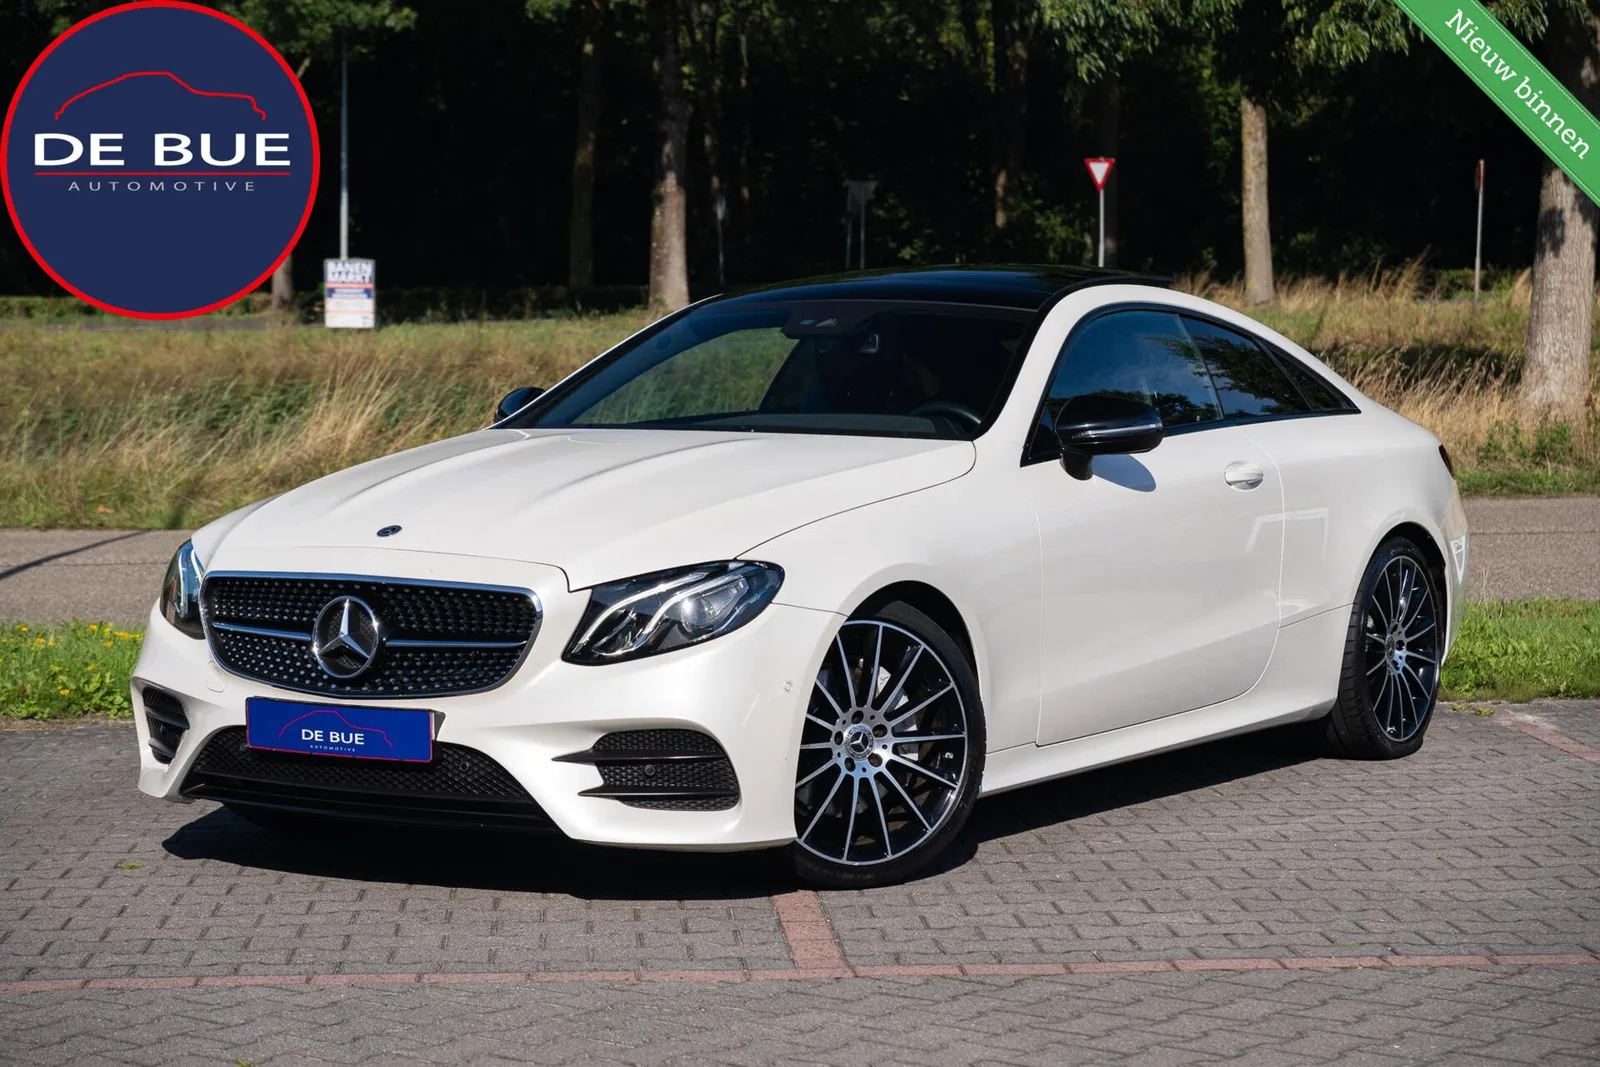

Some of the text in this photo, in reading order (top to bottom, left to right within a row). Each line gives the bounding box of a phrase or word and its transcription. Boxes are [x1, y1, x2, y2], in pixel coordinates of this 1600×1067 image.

[301, 729, 365, 745] DE BUE
[310, 744, 356, 752] AUTOMOTIVE
